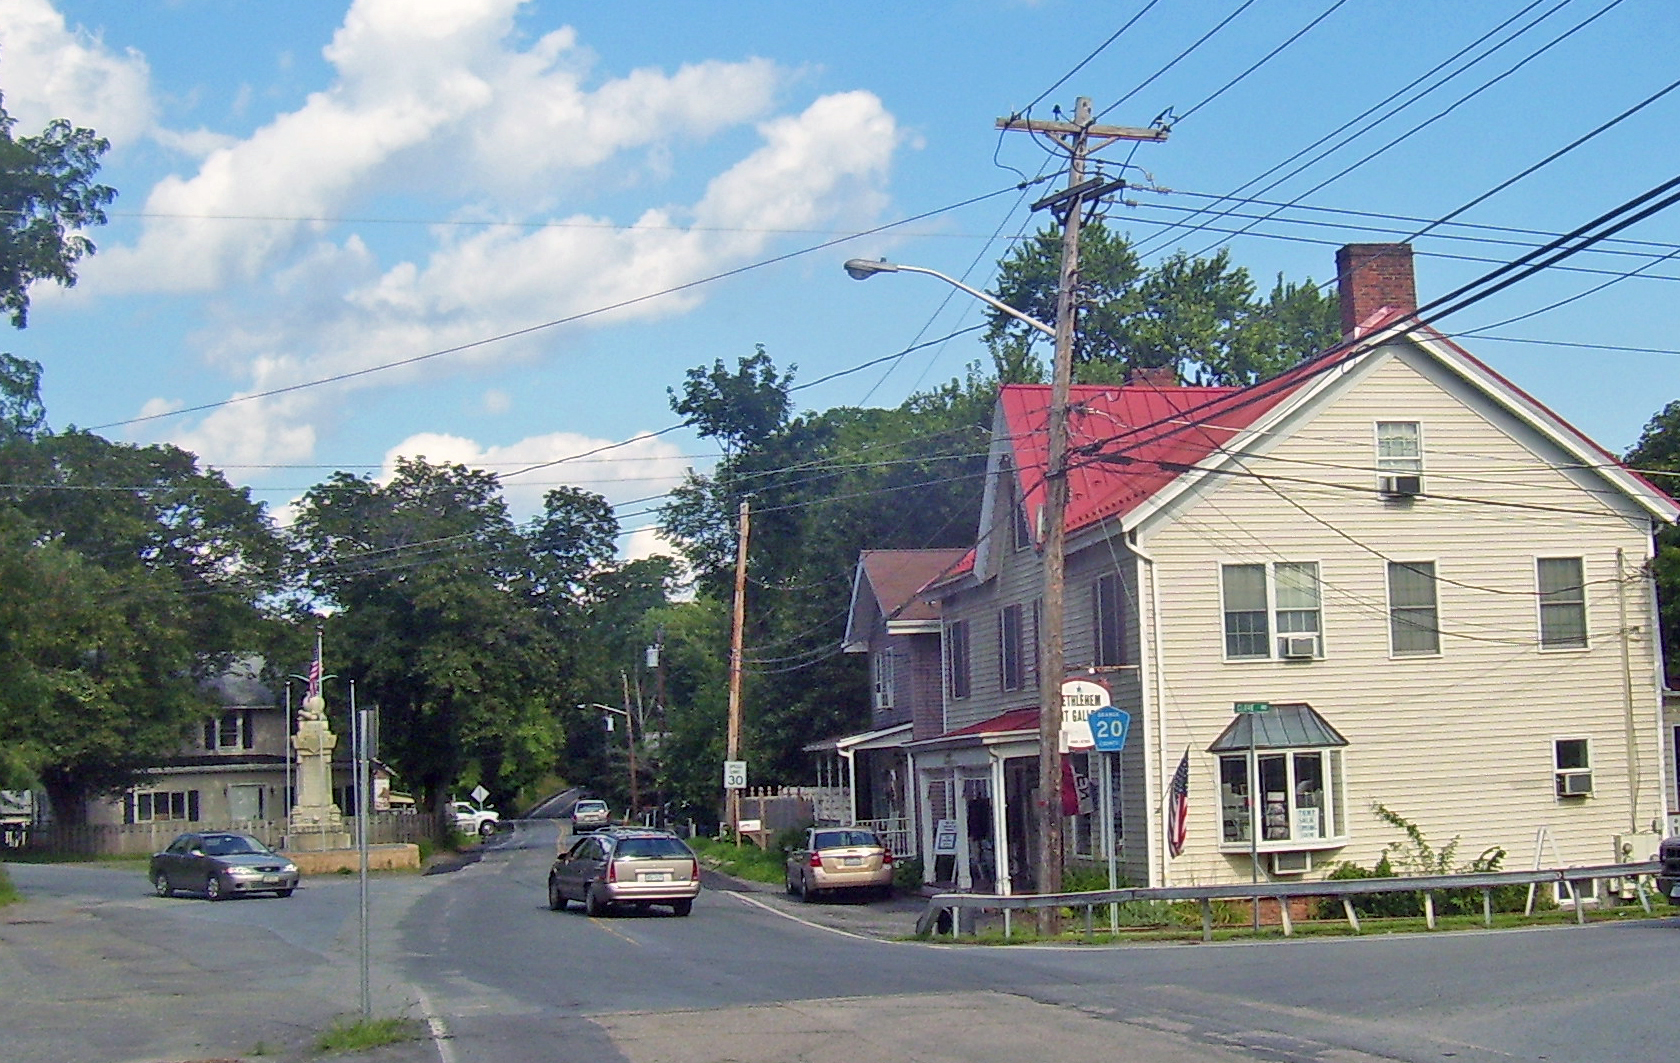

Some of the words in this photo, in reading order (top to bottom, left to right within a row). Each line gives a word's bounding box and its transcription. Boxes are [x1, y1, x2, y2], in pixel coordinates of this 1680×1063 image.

[1062, 694, 1102, 707] ETHLEHEM
[1096, 720, 1123, 738] 20
[727, 775, 744, 786] 30
